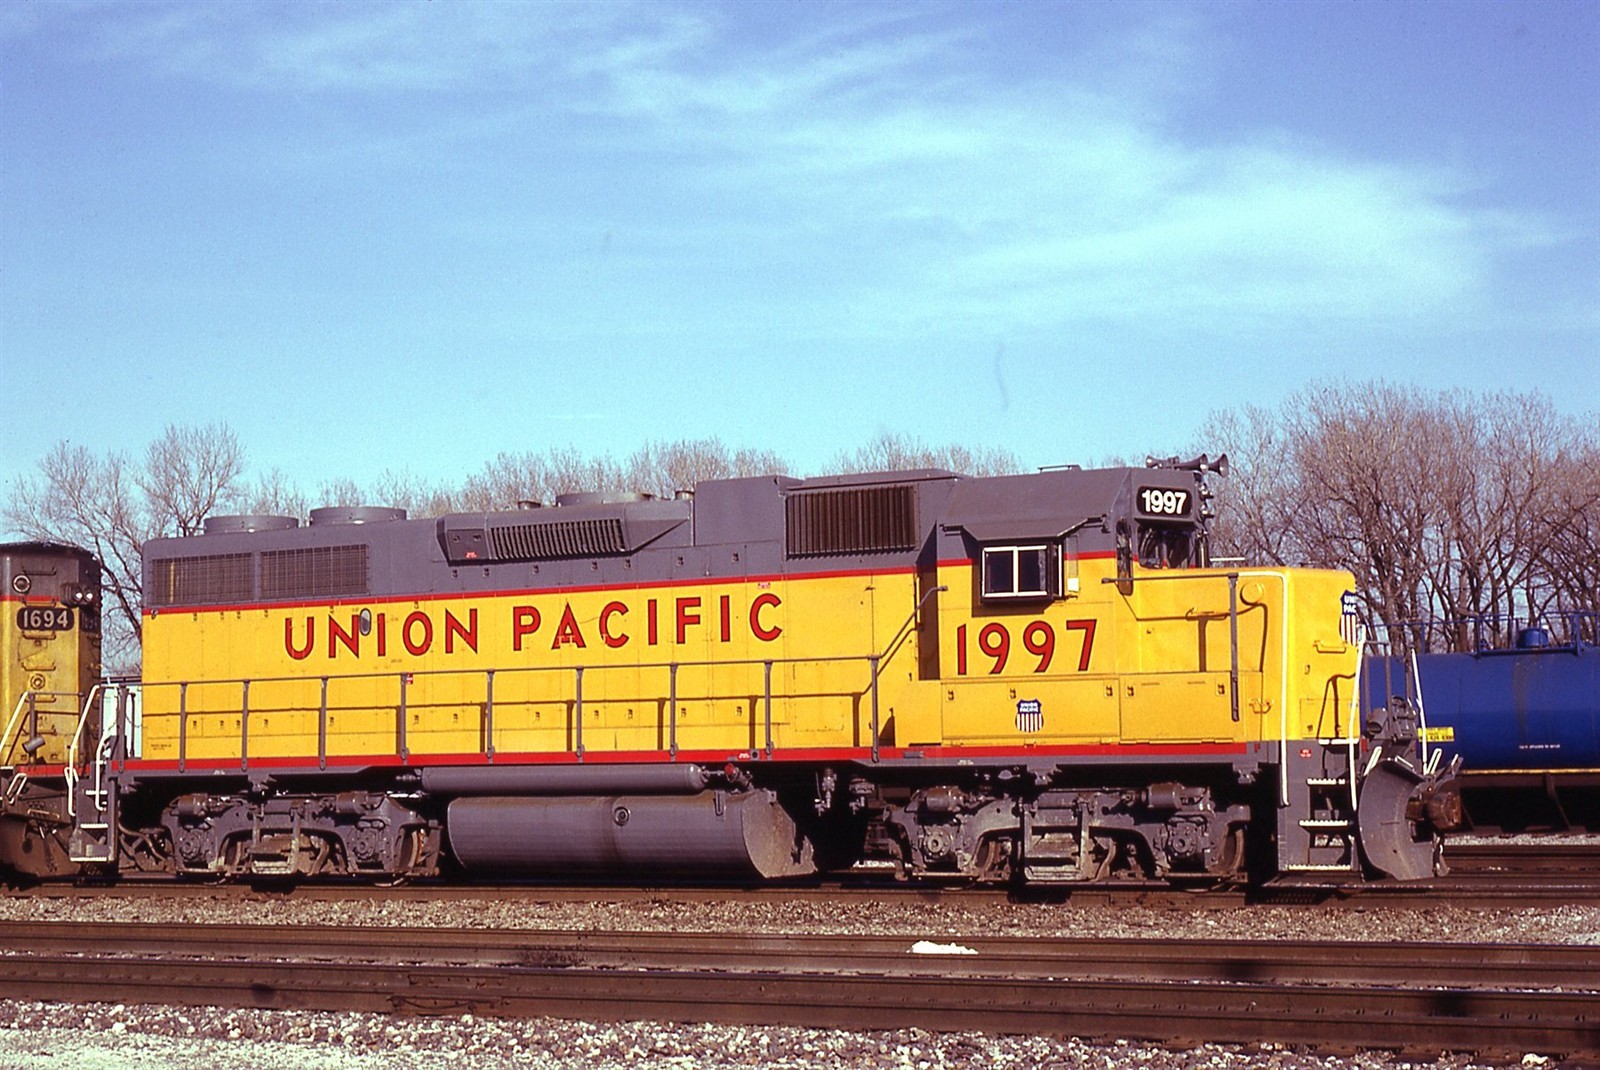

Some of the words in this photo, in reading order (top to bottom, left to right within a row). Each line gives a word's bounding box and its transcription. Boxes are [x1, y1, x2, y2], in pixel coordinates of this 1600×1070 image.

[1141, 489, 1187, 515] 1997
[23, 609, 68, 628] 1694
[284, 608, 478, 660] UNION
[512, 592, 783, 651] PACIFIC
[956, 618, 1098, 676] 1997
